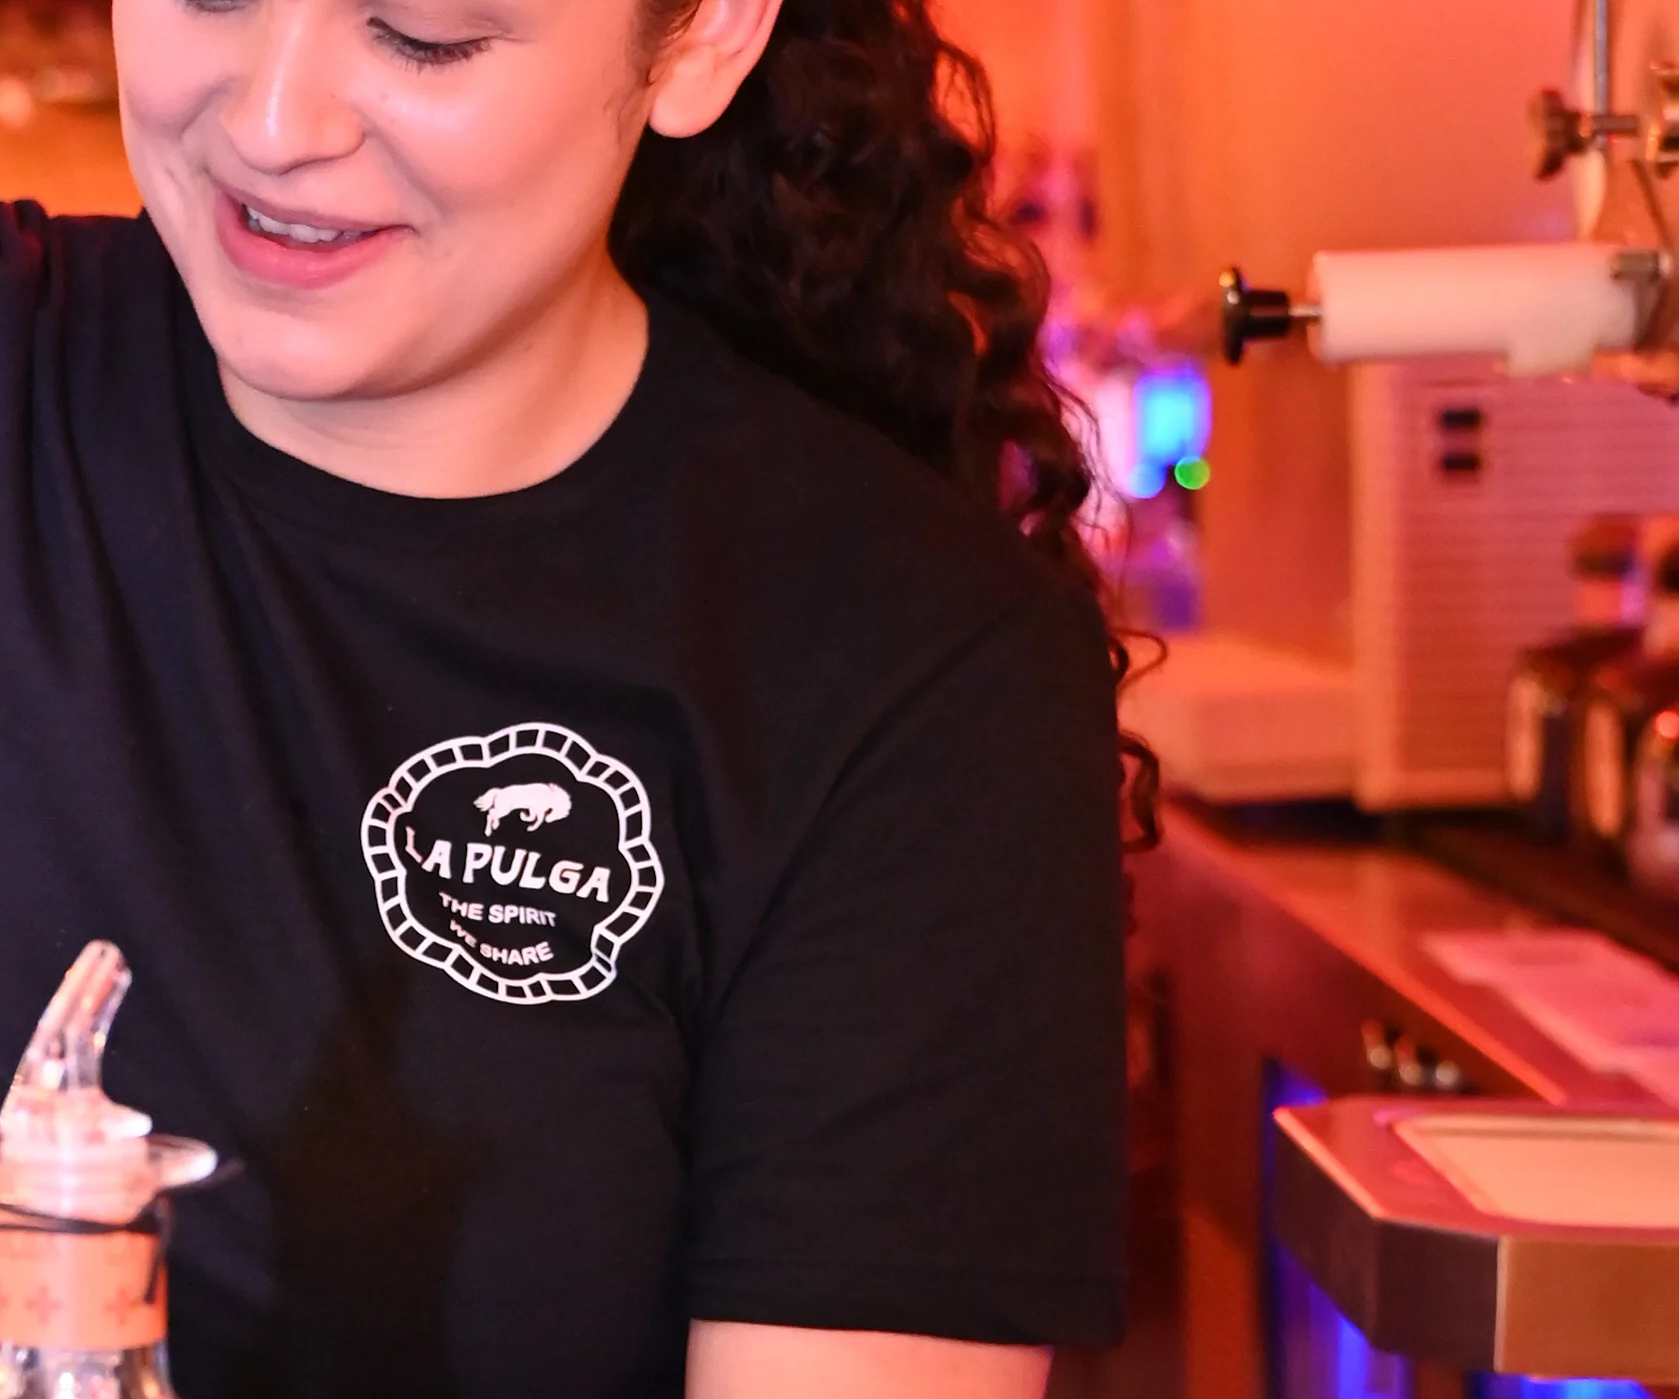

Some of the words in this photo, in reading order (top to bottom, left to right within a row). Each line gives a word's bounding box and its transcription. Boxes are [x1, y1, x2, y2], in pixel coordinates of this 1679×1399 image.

[405, 826, 452, 880] LA
[462, 842, 611, 903] PULGA
[439, 890, 484, 922] THE
[487, 903, 557, 928] SPIRIT
[449, 919, 477, 948] WE
[480, 940, 555, 966] SHARE
